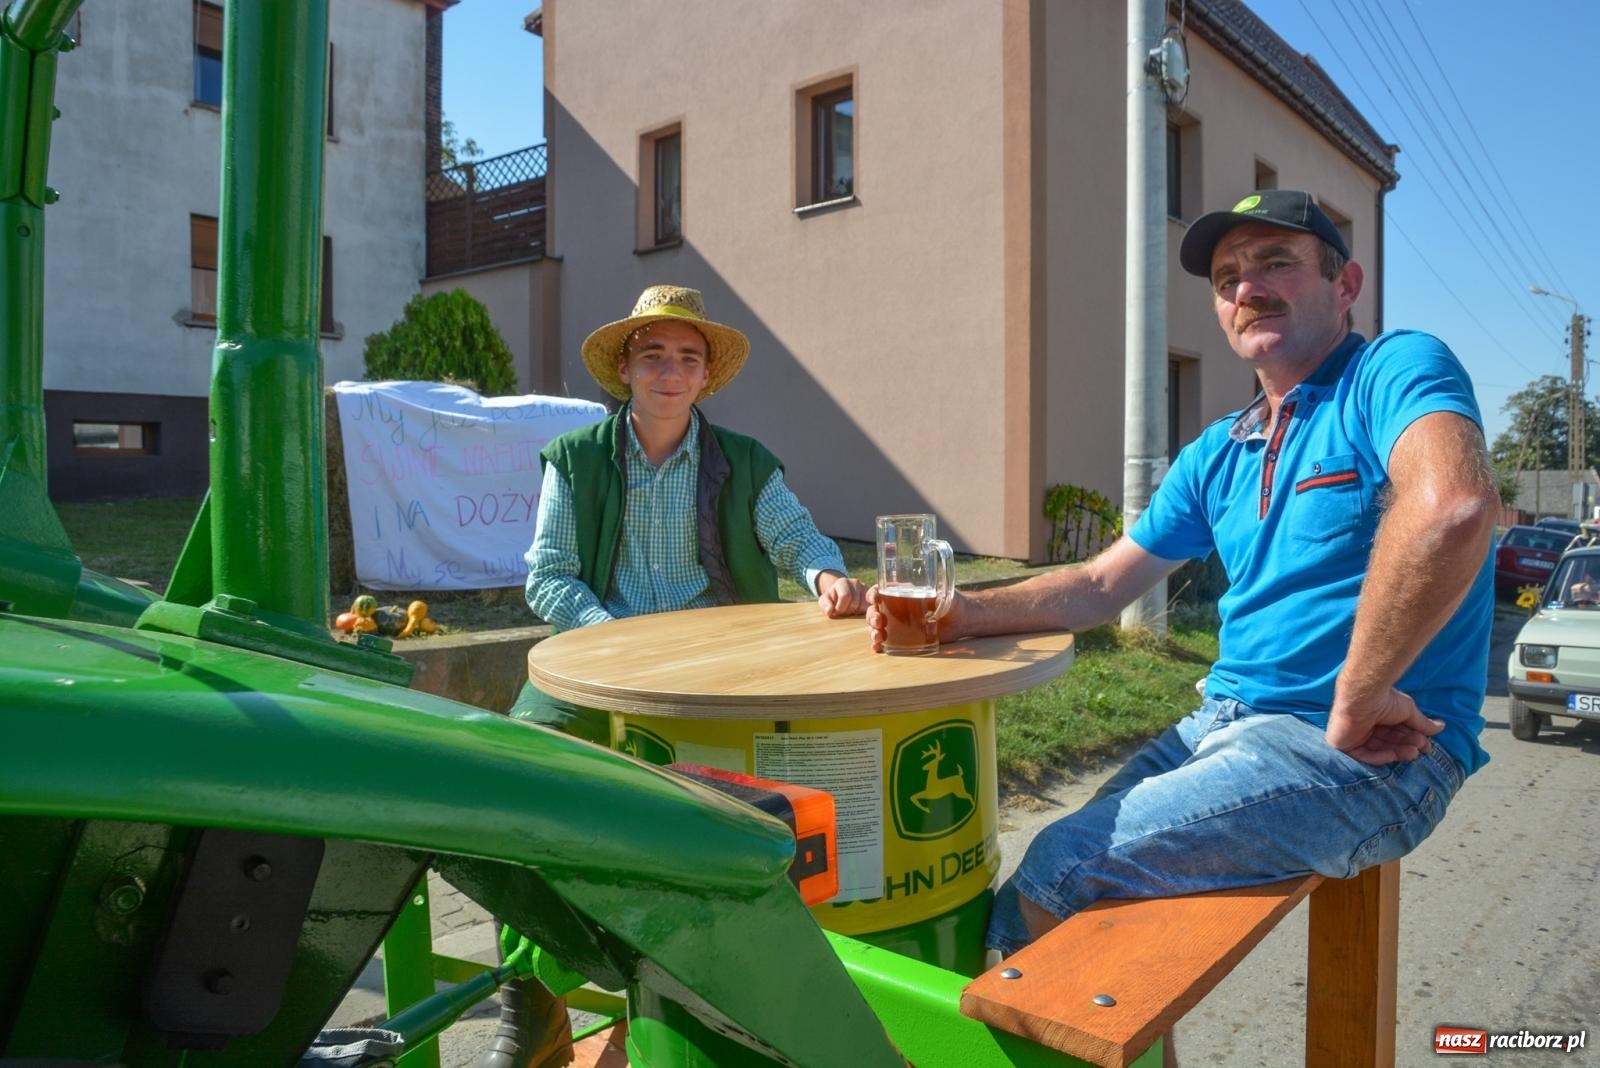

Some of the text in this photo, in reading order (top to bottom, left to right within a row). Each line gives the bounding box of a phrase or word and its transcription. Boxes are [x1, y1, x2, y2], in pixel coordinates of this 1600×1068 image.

[352, 391, 404, 444] My
[395, 499, 430, 533] NA
[456, 487, 540, 528] DOŻY
[1579, 696, 1600, 711] SR
[832, 864, 935, 908] HN
